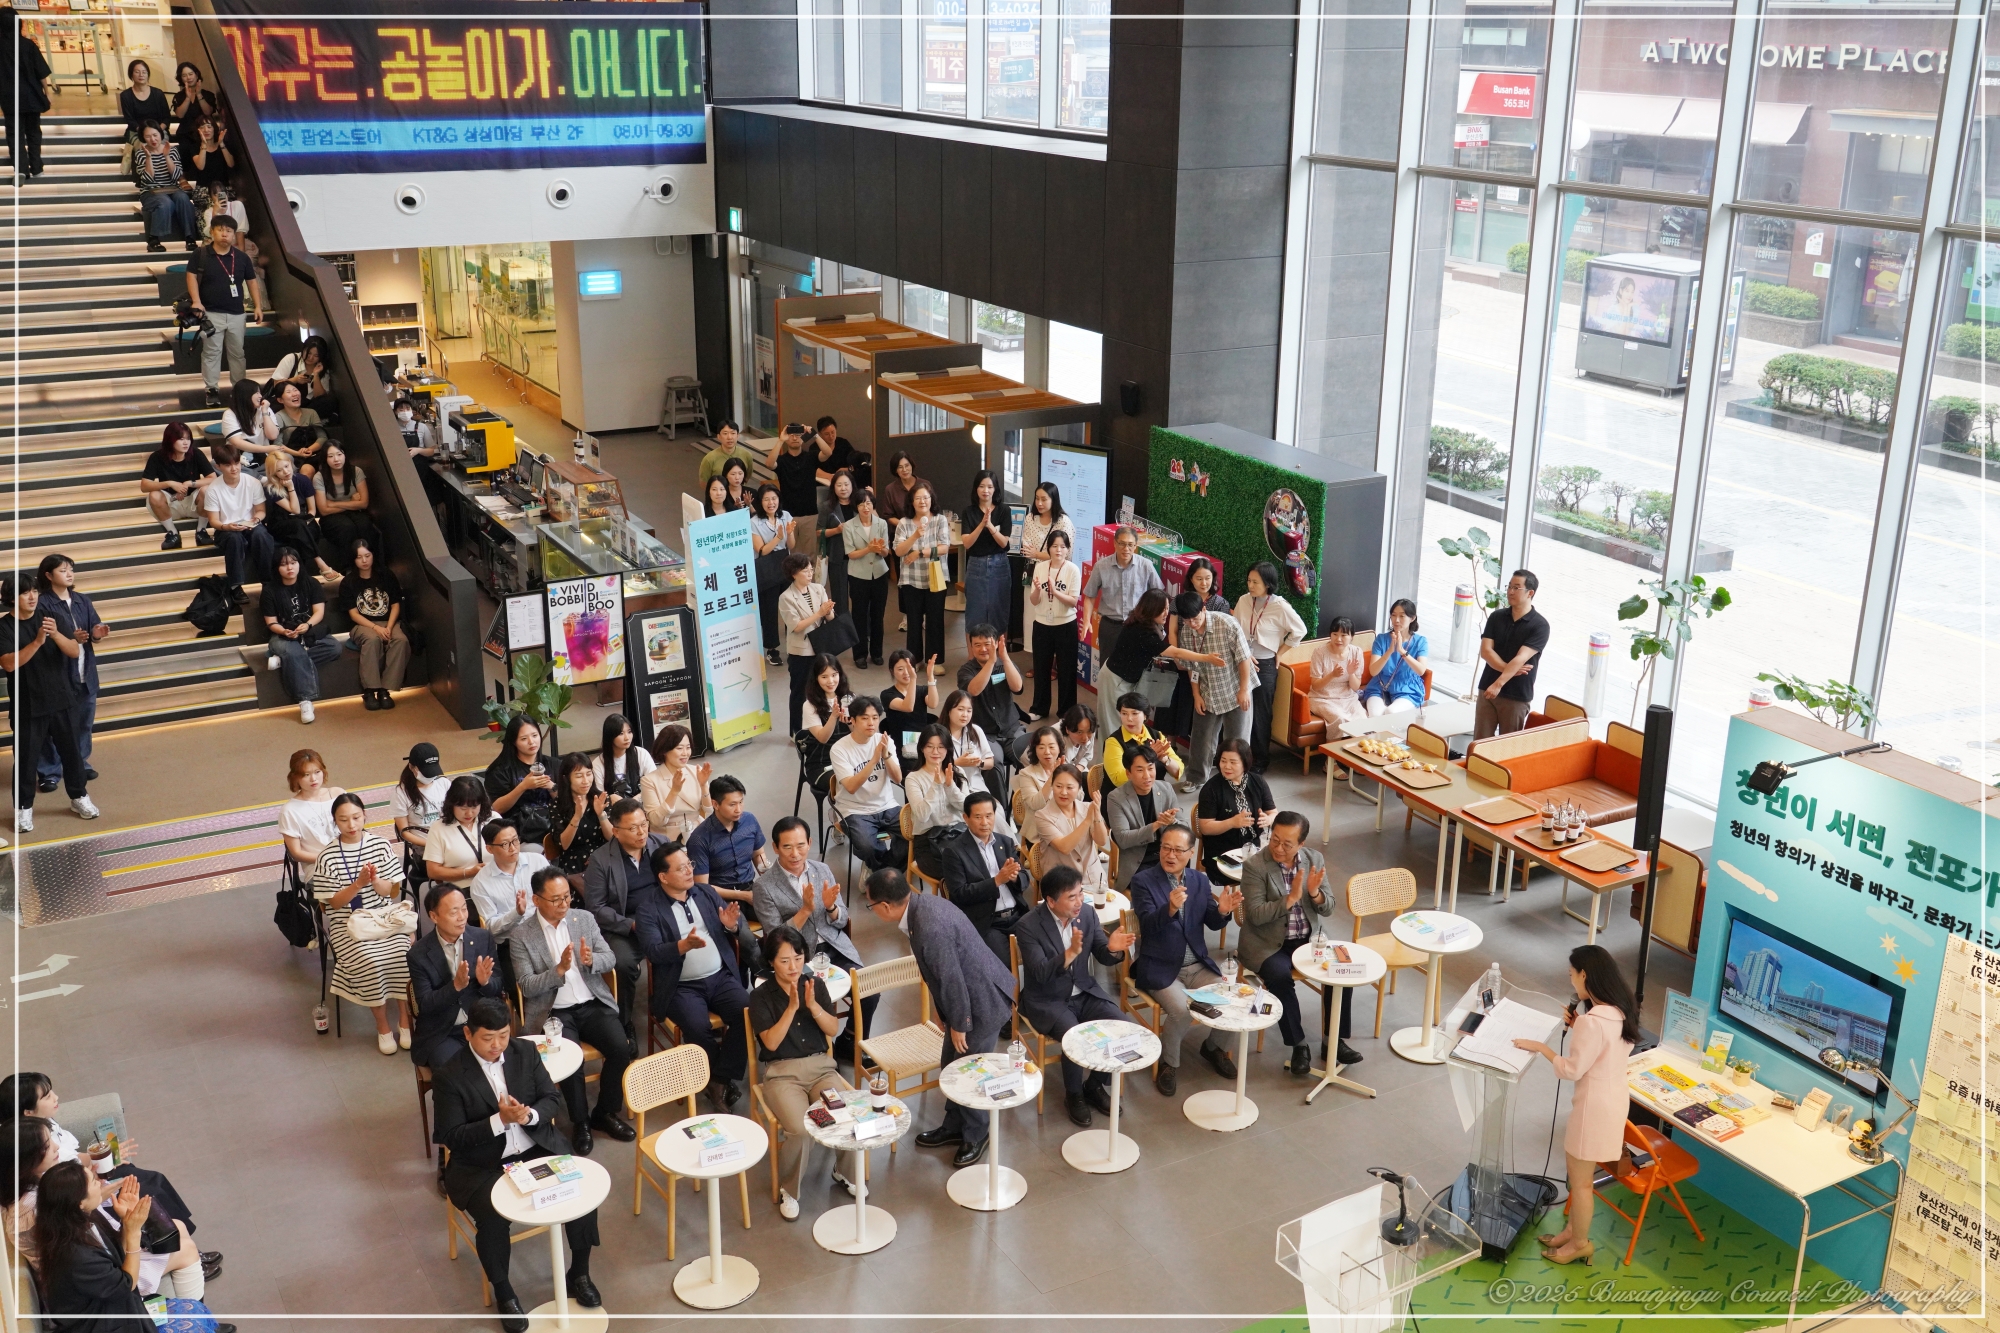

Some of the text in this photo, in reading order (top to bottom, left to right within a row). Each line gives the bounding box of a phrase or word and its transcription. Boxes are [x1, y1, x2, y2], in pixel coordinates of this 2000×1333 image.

[377, 28, 565, 101] 공놀이가.
[569, 29, 701, 98] 아니다.
[1642, 41, 1660, 62] A
[1668, 37, 1827, 70] TWOOME
[926, 56, 965, 79] 계주
[1493, 84, 1530, 96] Busan Bank
[1503, 98, 1530, 109] 365코너
[301, 128, 382, 146] 팝업스토어
[413, 126, 458, 143] KT&G
[463, 126, 523, 143] 상상마당
[531, 124, 560, 143] 부산
[566, 124, 585, 141] 2F
[695, 531, 724, 548] 청년마켓
[1041, 580, 1067, 592] mrie
[588, 599, 615, 611] BOO
[703, 588, 754, 616] 프로그램
[1825, 808, 1896, 869] 서면,
[1729, 819, 2000, 950] 청년의 창의가 상권을 바꾸고, 문화가 도
[1971, 965, 2000, 987] (인생
[1947, 1080, 1969, 1099] 요즘
[1970, 1091, 1982, 1106] 내
[1918, 1190, 1969, 1229] 부산진구에
